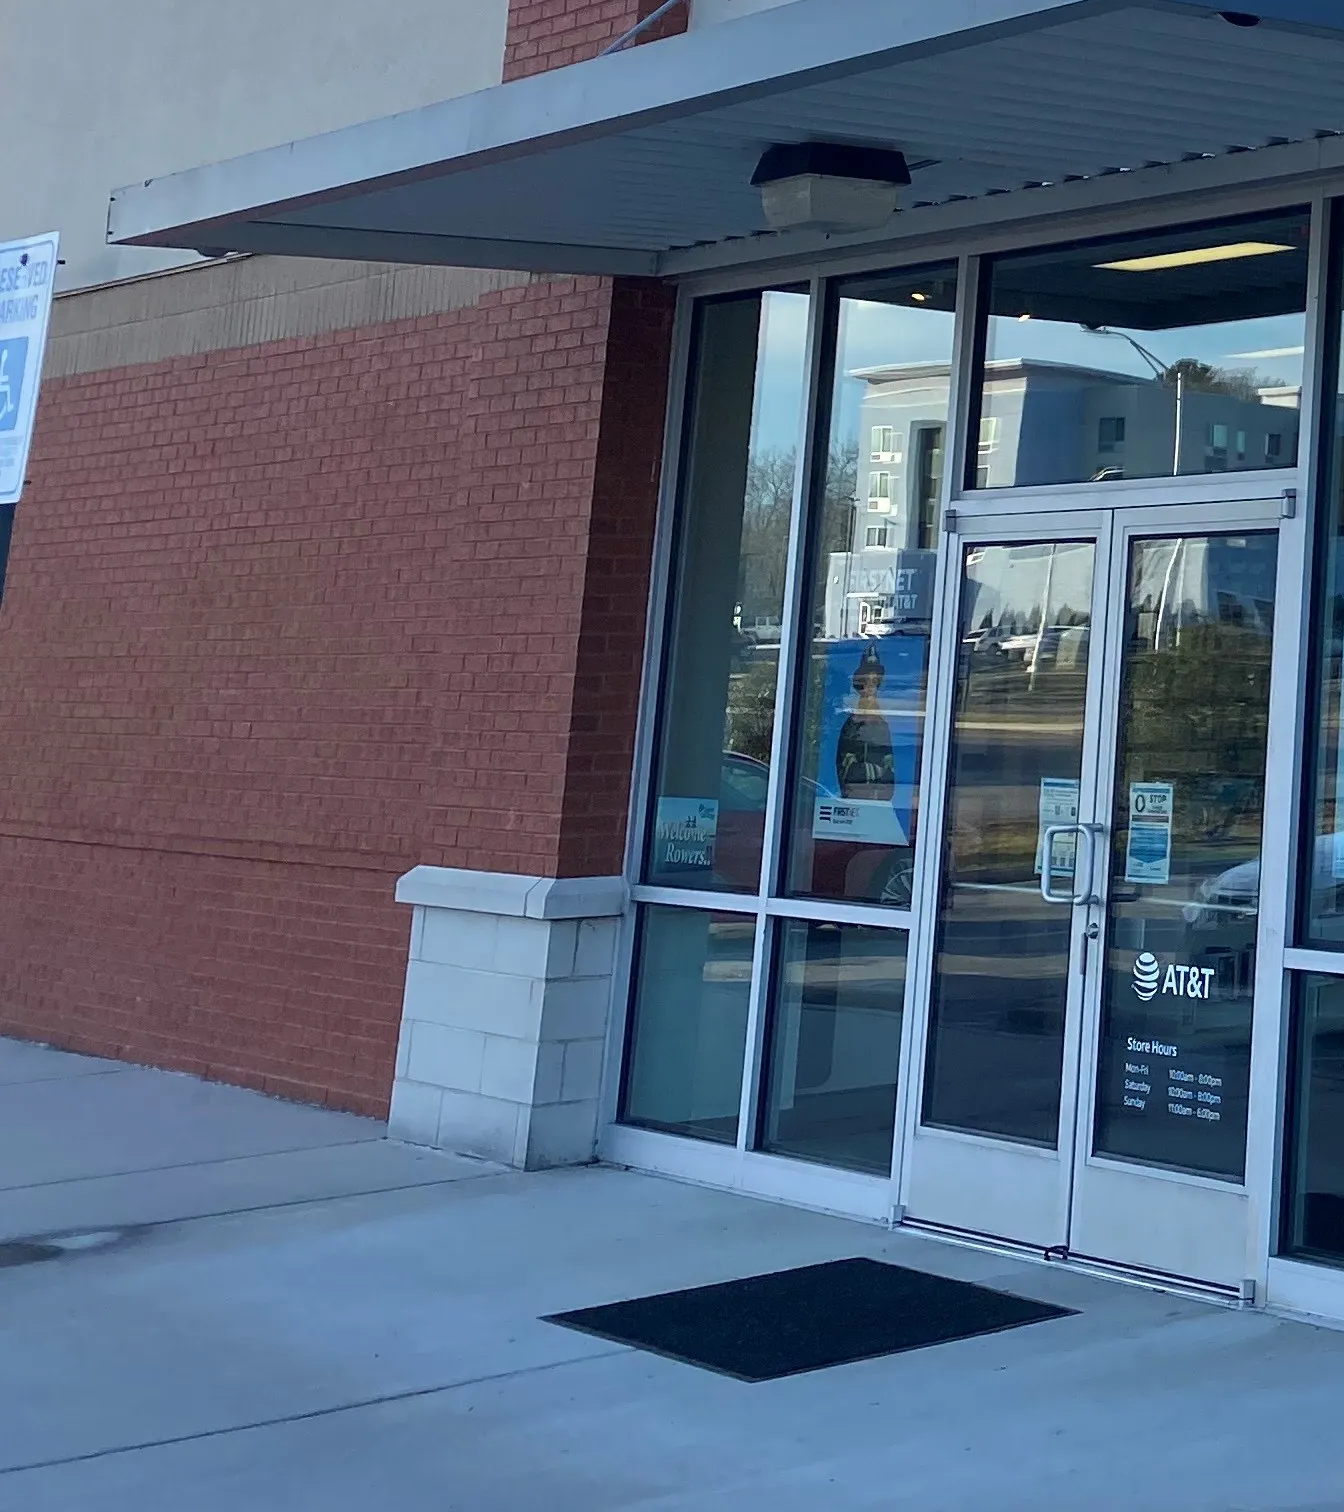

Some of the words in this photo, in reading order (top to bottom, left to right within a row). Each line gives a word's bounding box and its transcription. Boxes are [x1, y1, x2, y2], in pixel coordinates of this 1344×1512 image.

[0, 294, 39, 322] ARKING
[1162, 964, 1215, 999] AT&T
[1127, 1037, 1151, 1053] Store
[1152, 1040, 1178, 1057] Hours
[1125, 1063, 1149, 1076] Mon-Fri
[1124, 1079, 1151, 1095] Saturday
[1123, 1096, 1146, 1111] Sunday
